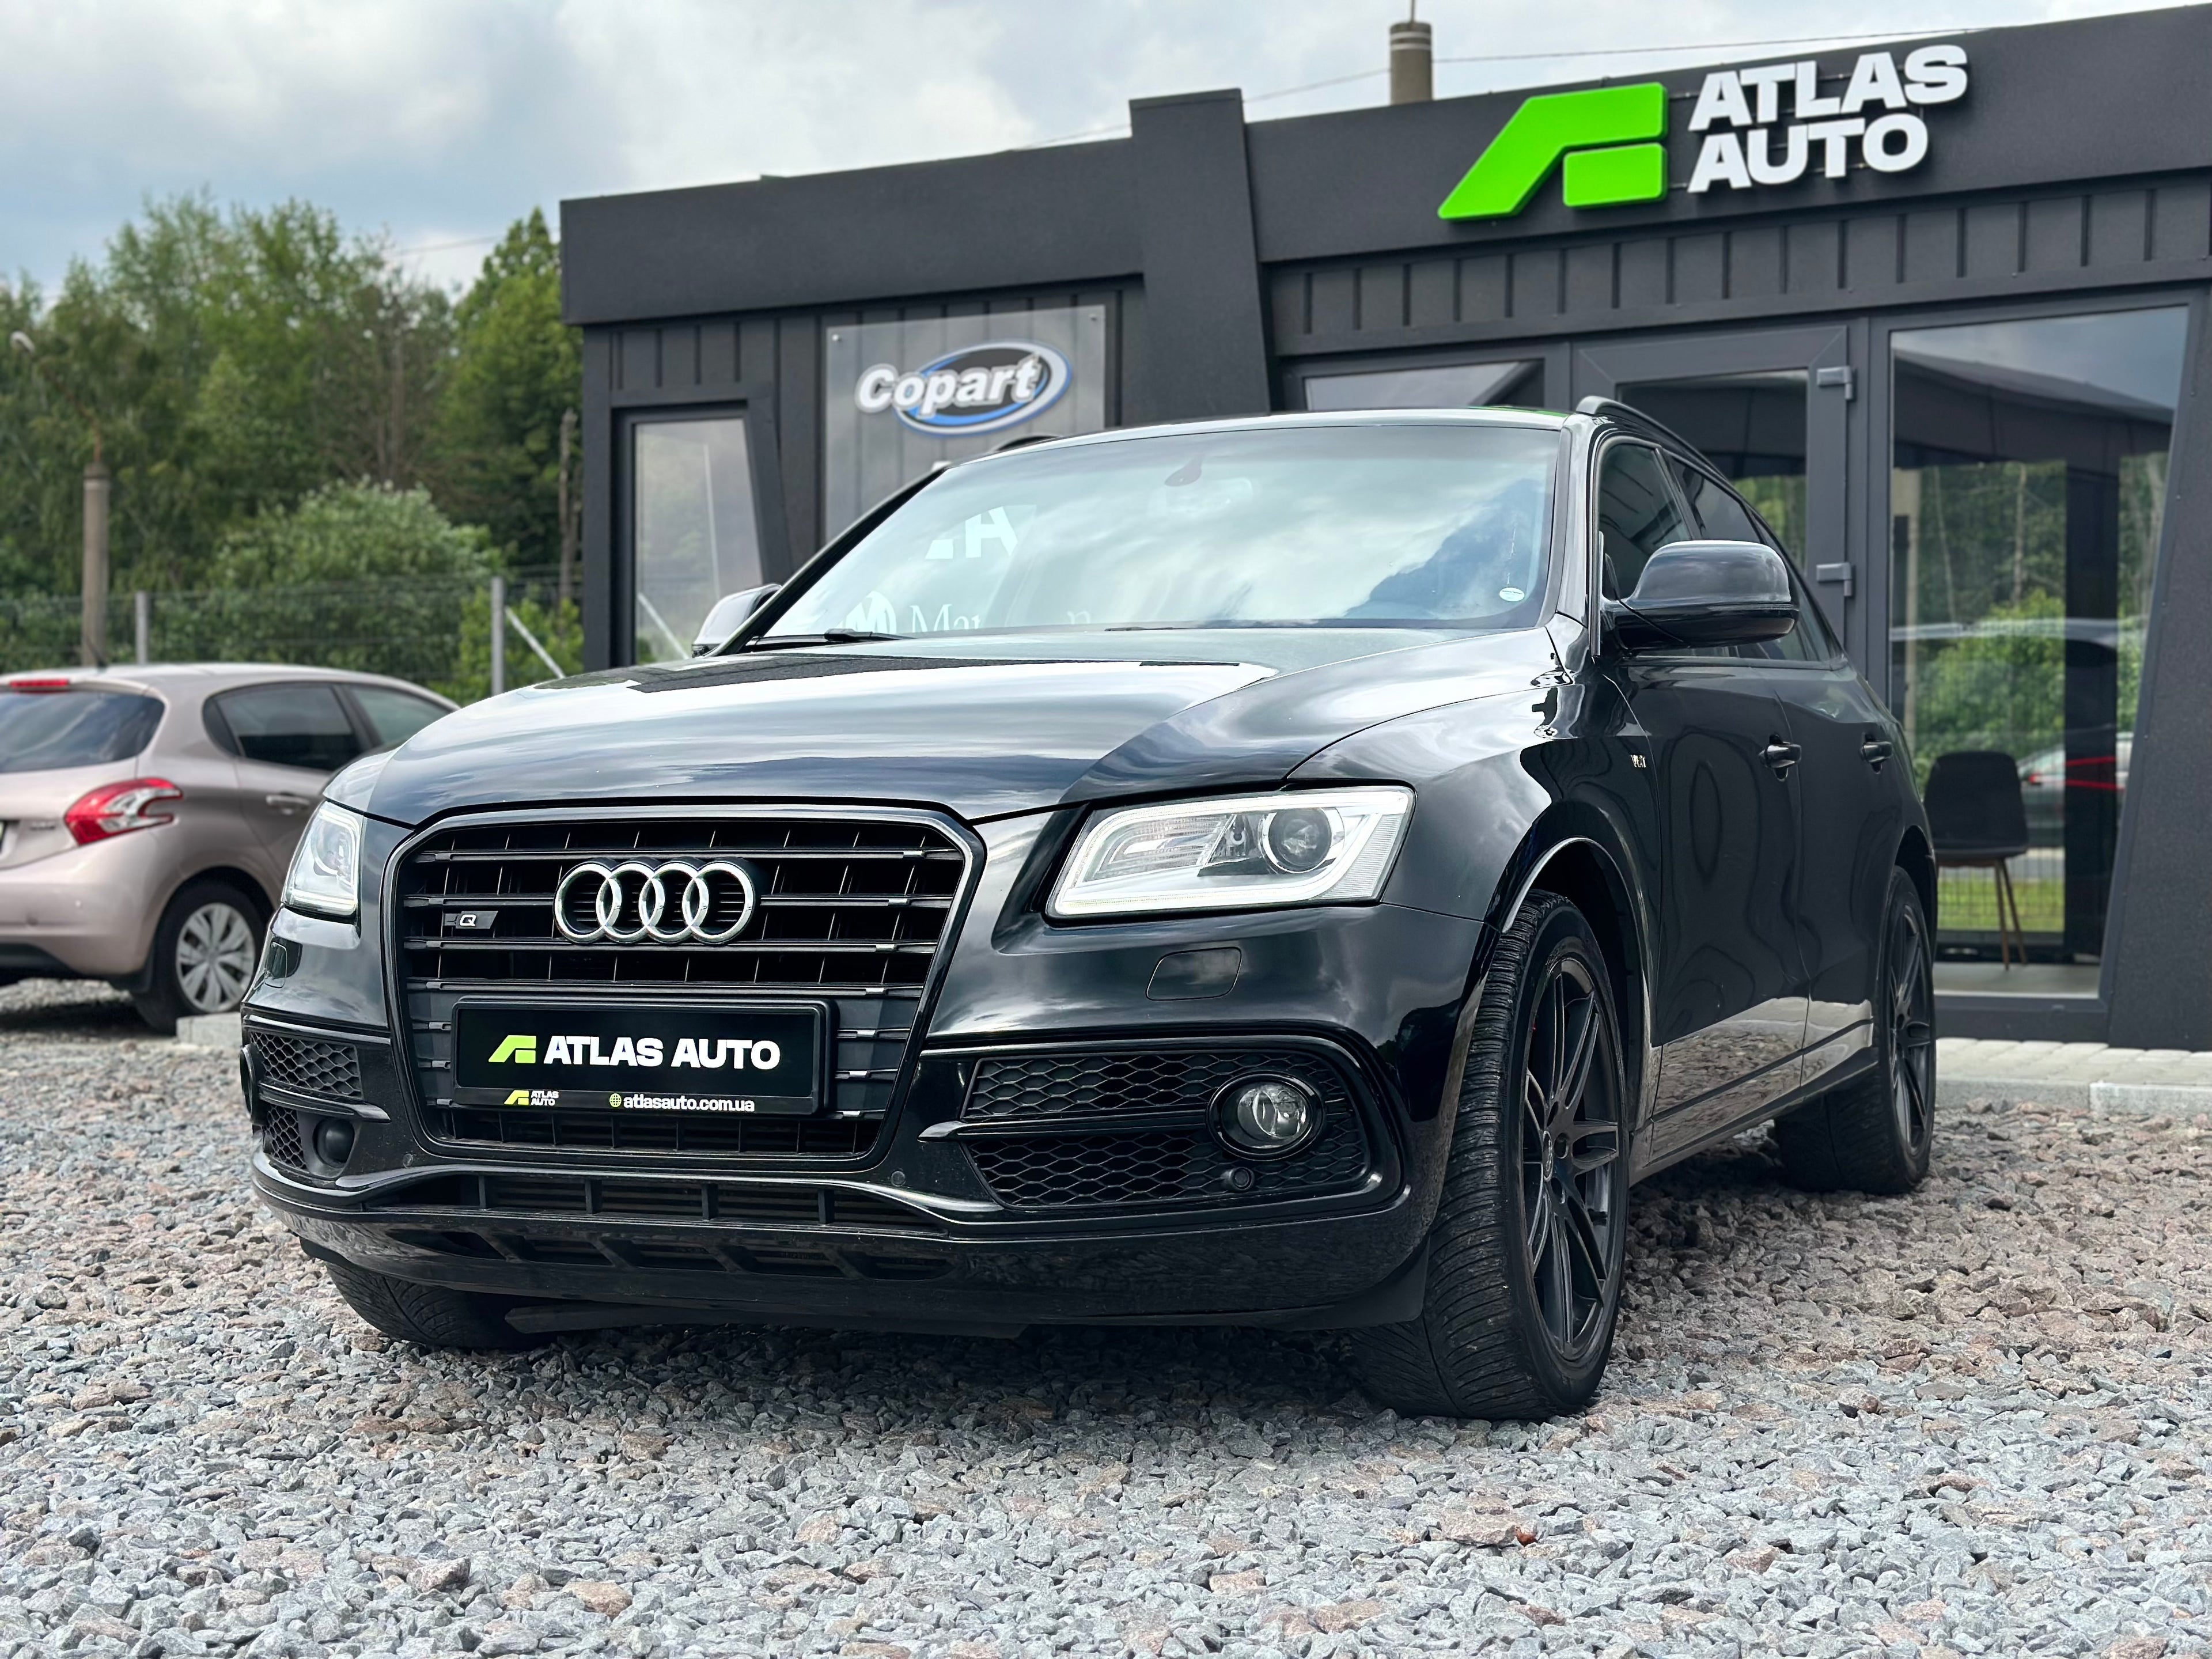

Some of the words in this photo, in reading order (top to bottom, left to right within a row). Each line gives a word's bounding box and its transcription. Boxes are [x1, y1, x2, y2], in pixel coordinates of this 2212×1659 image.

[1688, 45, 1968, 131] ATLAS
[1687, 113, 1928, 193] AUTO
[857, 357, 1039, 416] Copart
[543, 1035, 664, 1067] ATLAS
[671, 1038, 781, 1070] AUTO
[531, 1090, 559, 1099] ATLAS
[531, 1097, 555, 1106] AUTO
[623, 1093, 755, 1112] atlasauto.com.ua
